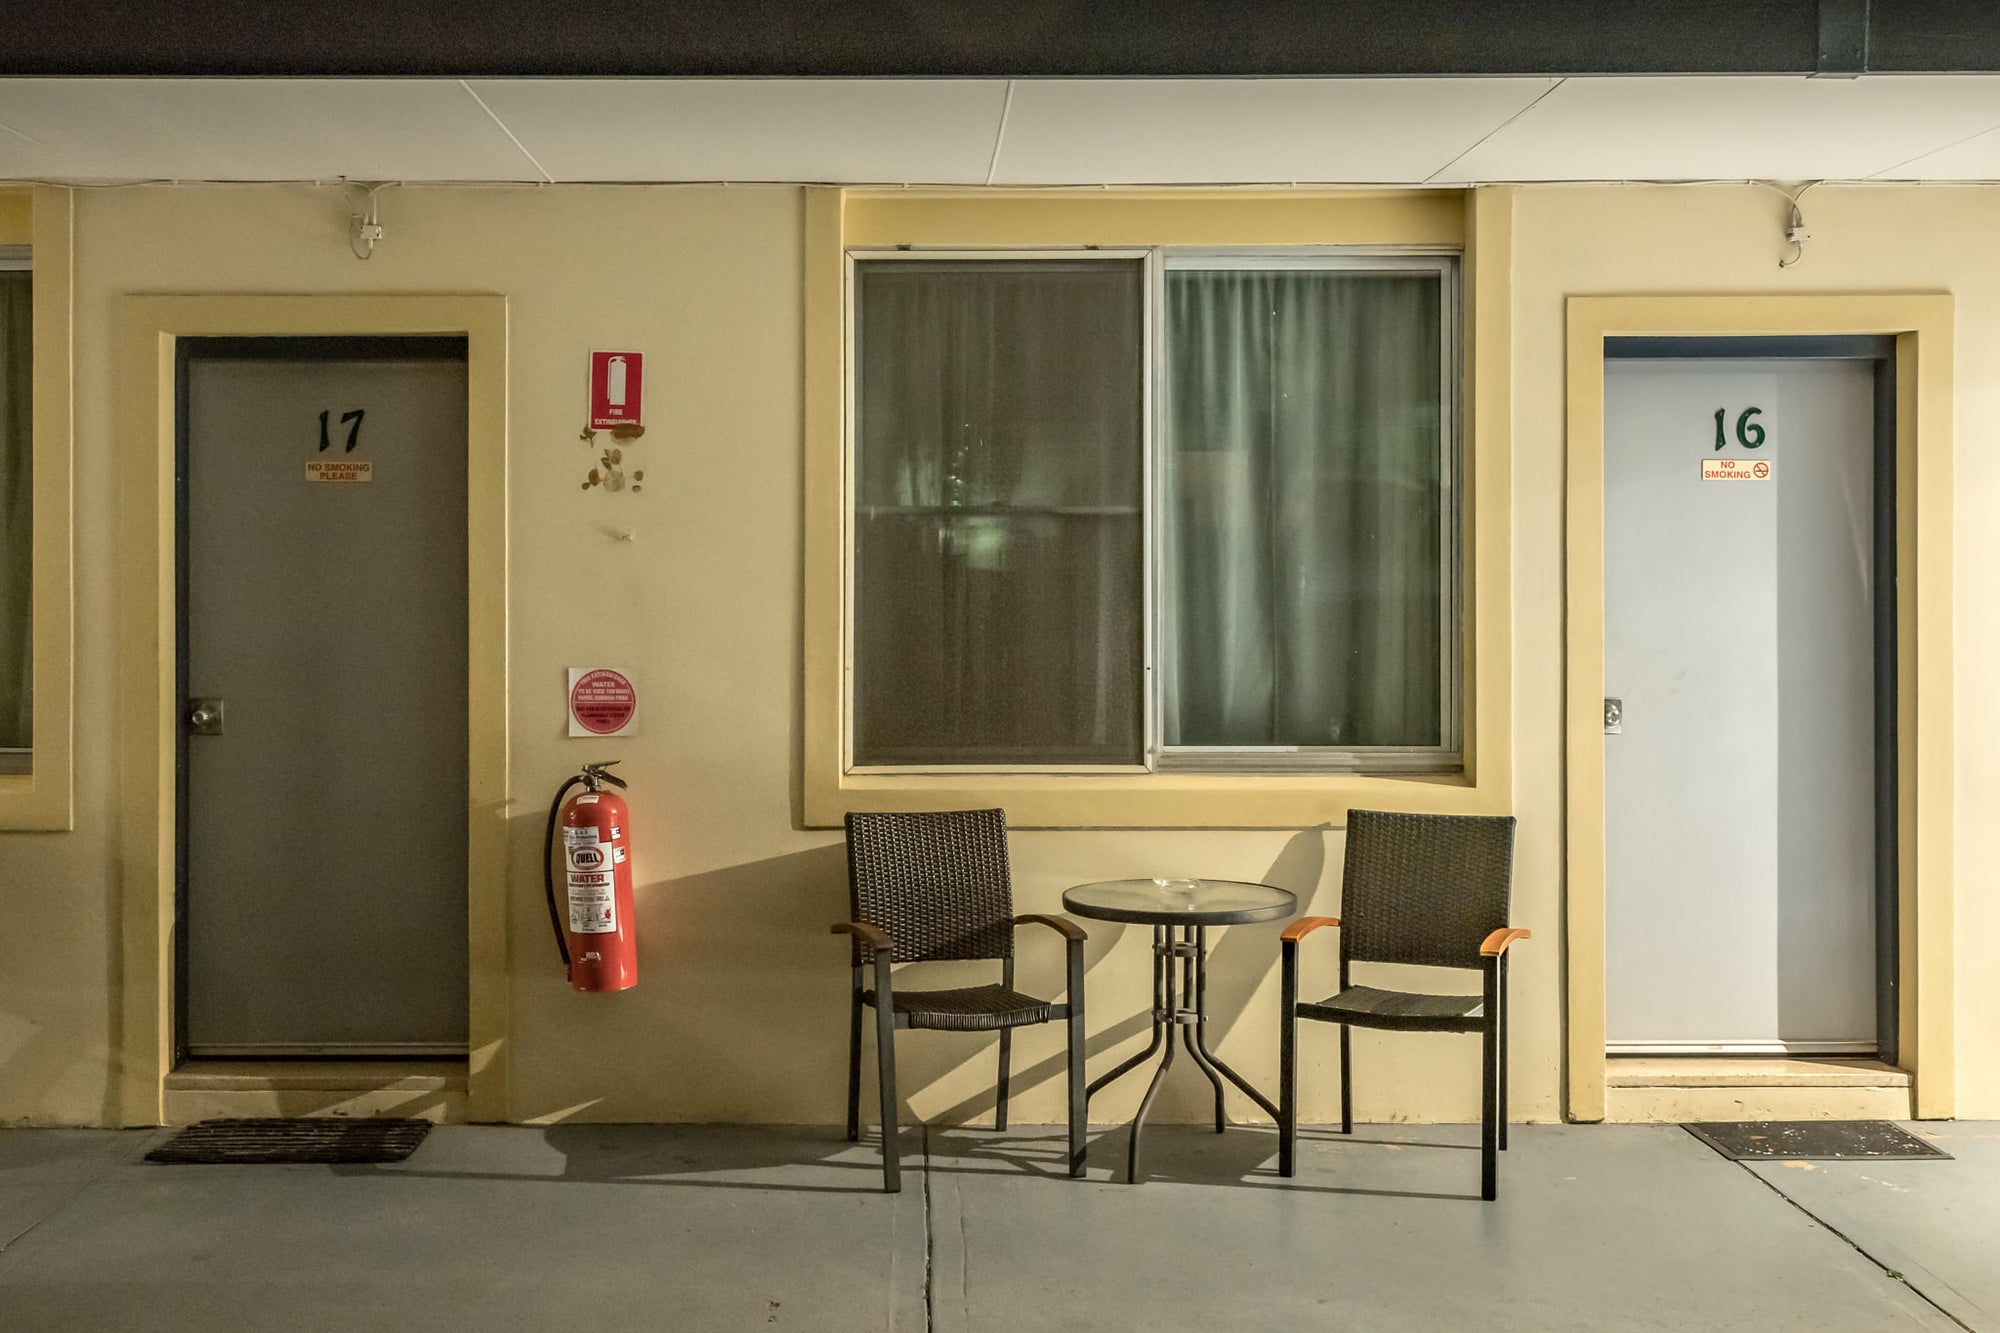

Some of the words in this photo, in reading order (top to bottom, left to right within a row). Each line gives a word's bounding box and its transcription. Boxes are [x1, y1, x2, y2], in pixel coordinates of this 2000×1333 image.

[319, 409, 365, 453] 17
[1714, 407, 1766, 451] 16
[307, 463, 322, 471] NO
[324, 463, 370, 472] SMOKING
[1720, 461, 1736, 469] NO
[319, 472, 358, 480] PLEASE
[1704, 470, 1751, 479] SMOKING
[576, 852, 600, 864] QUELL
[570, 874, 604, 883] WATER
